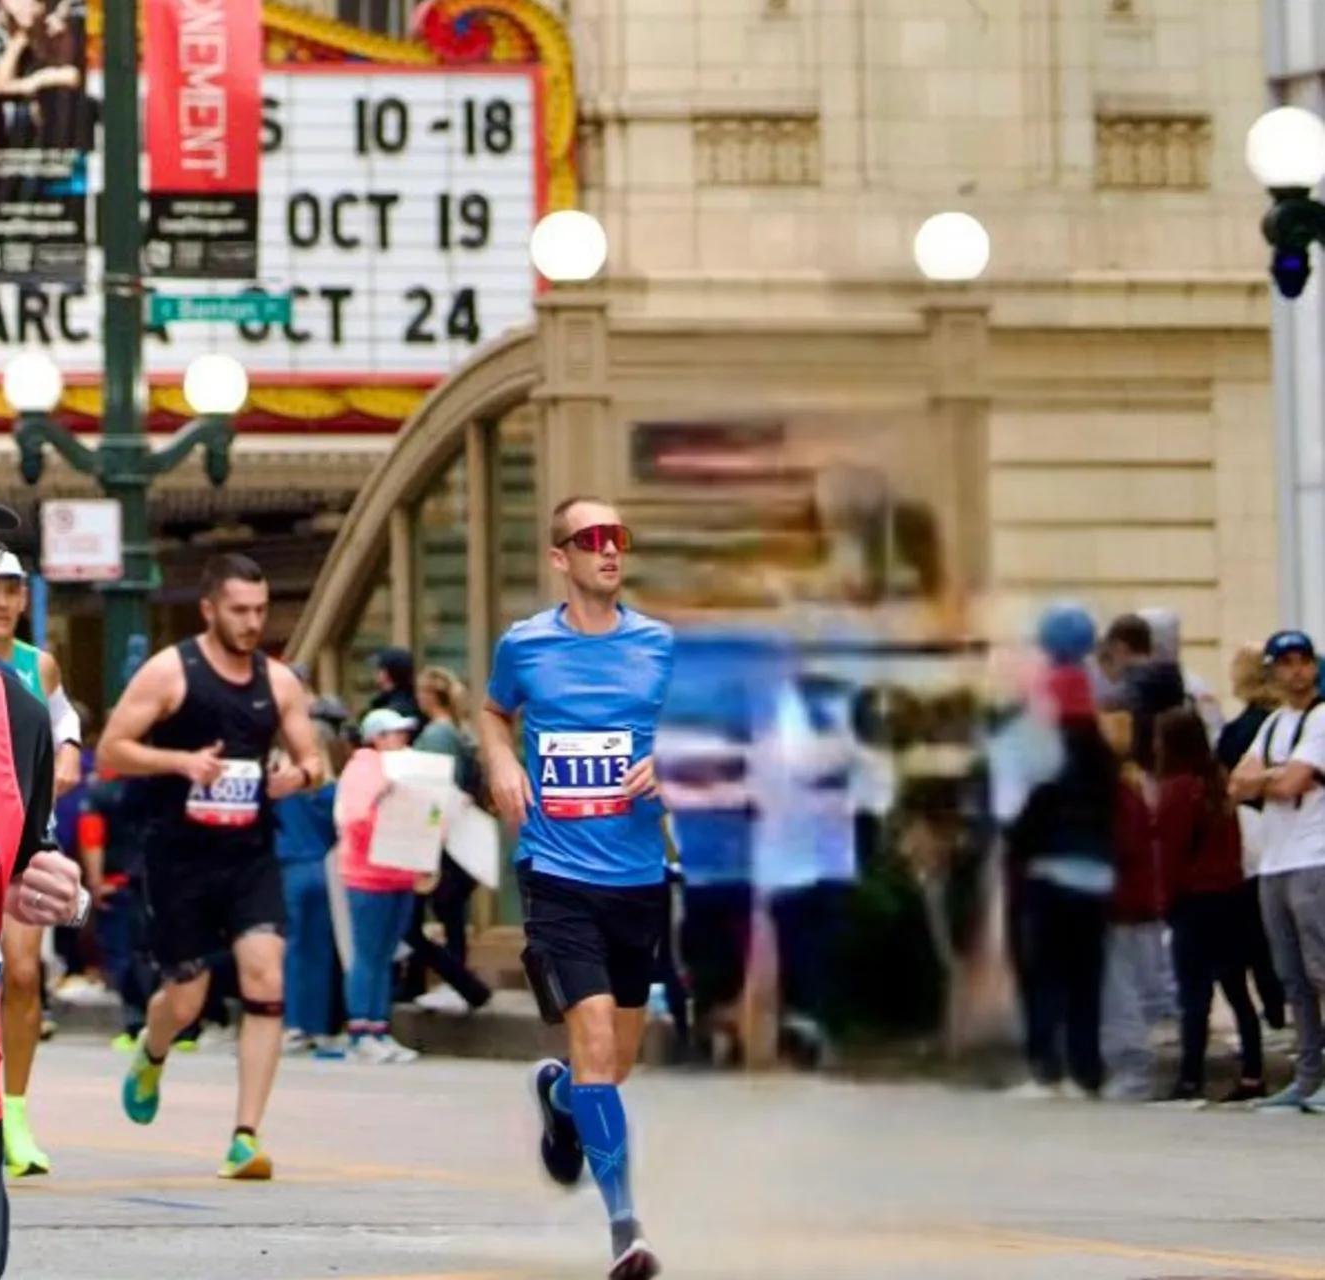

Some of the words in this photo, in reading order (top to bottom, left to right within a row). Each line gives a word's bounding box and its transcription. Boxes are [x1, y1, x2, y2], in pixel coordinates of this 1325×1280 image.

[287, 192, 400, 250] OCT
[437, 193, 491, 250] 19
[405, 287, 481, 344] 24
[542, 757, 559, 784] A
